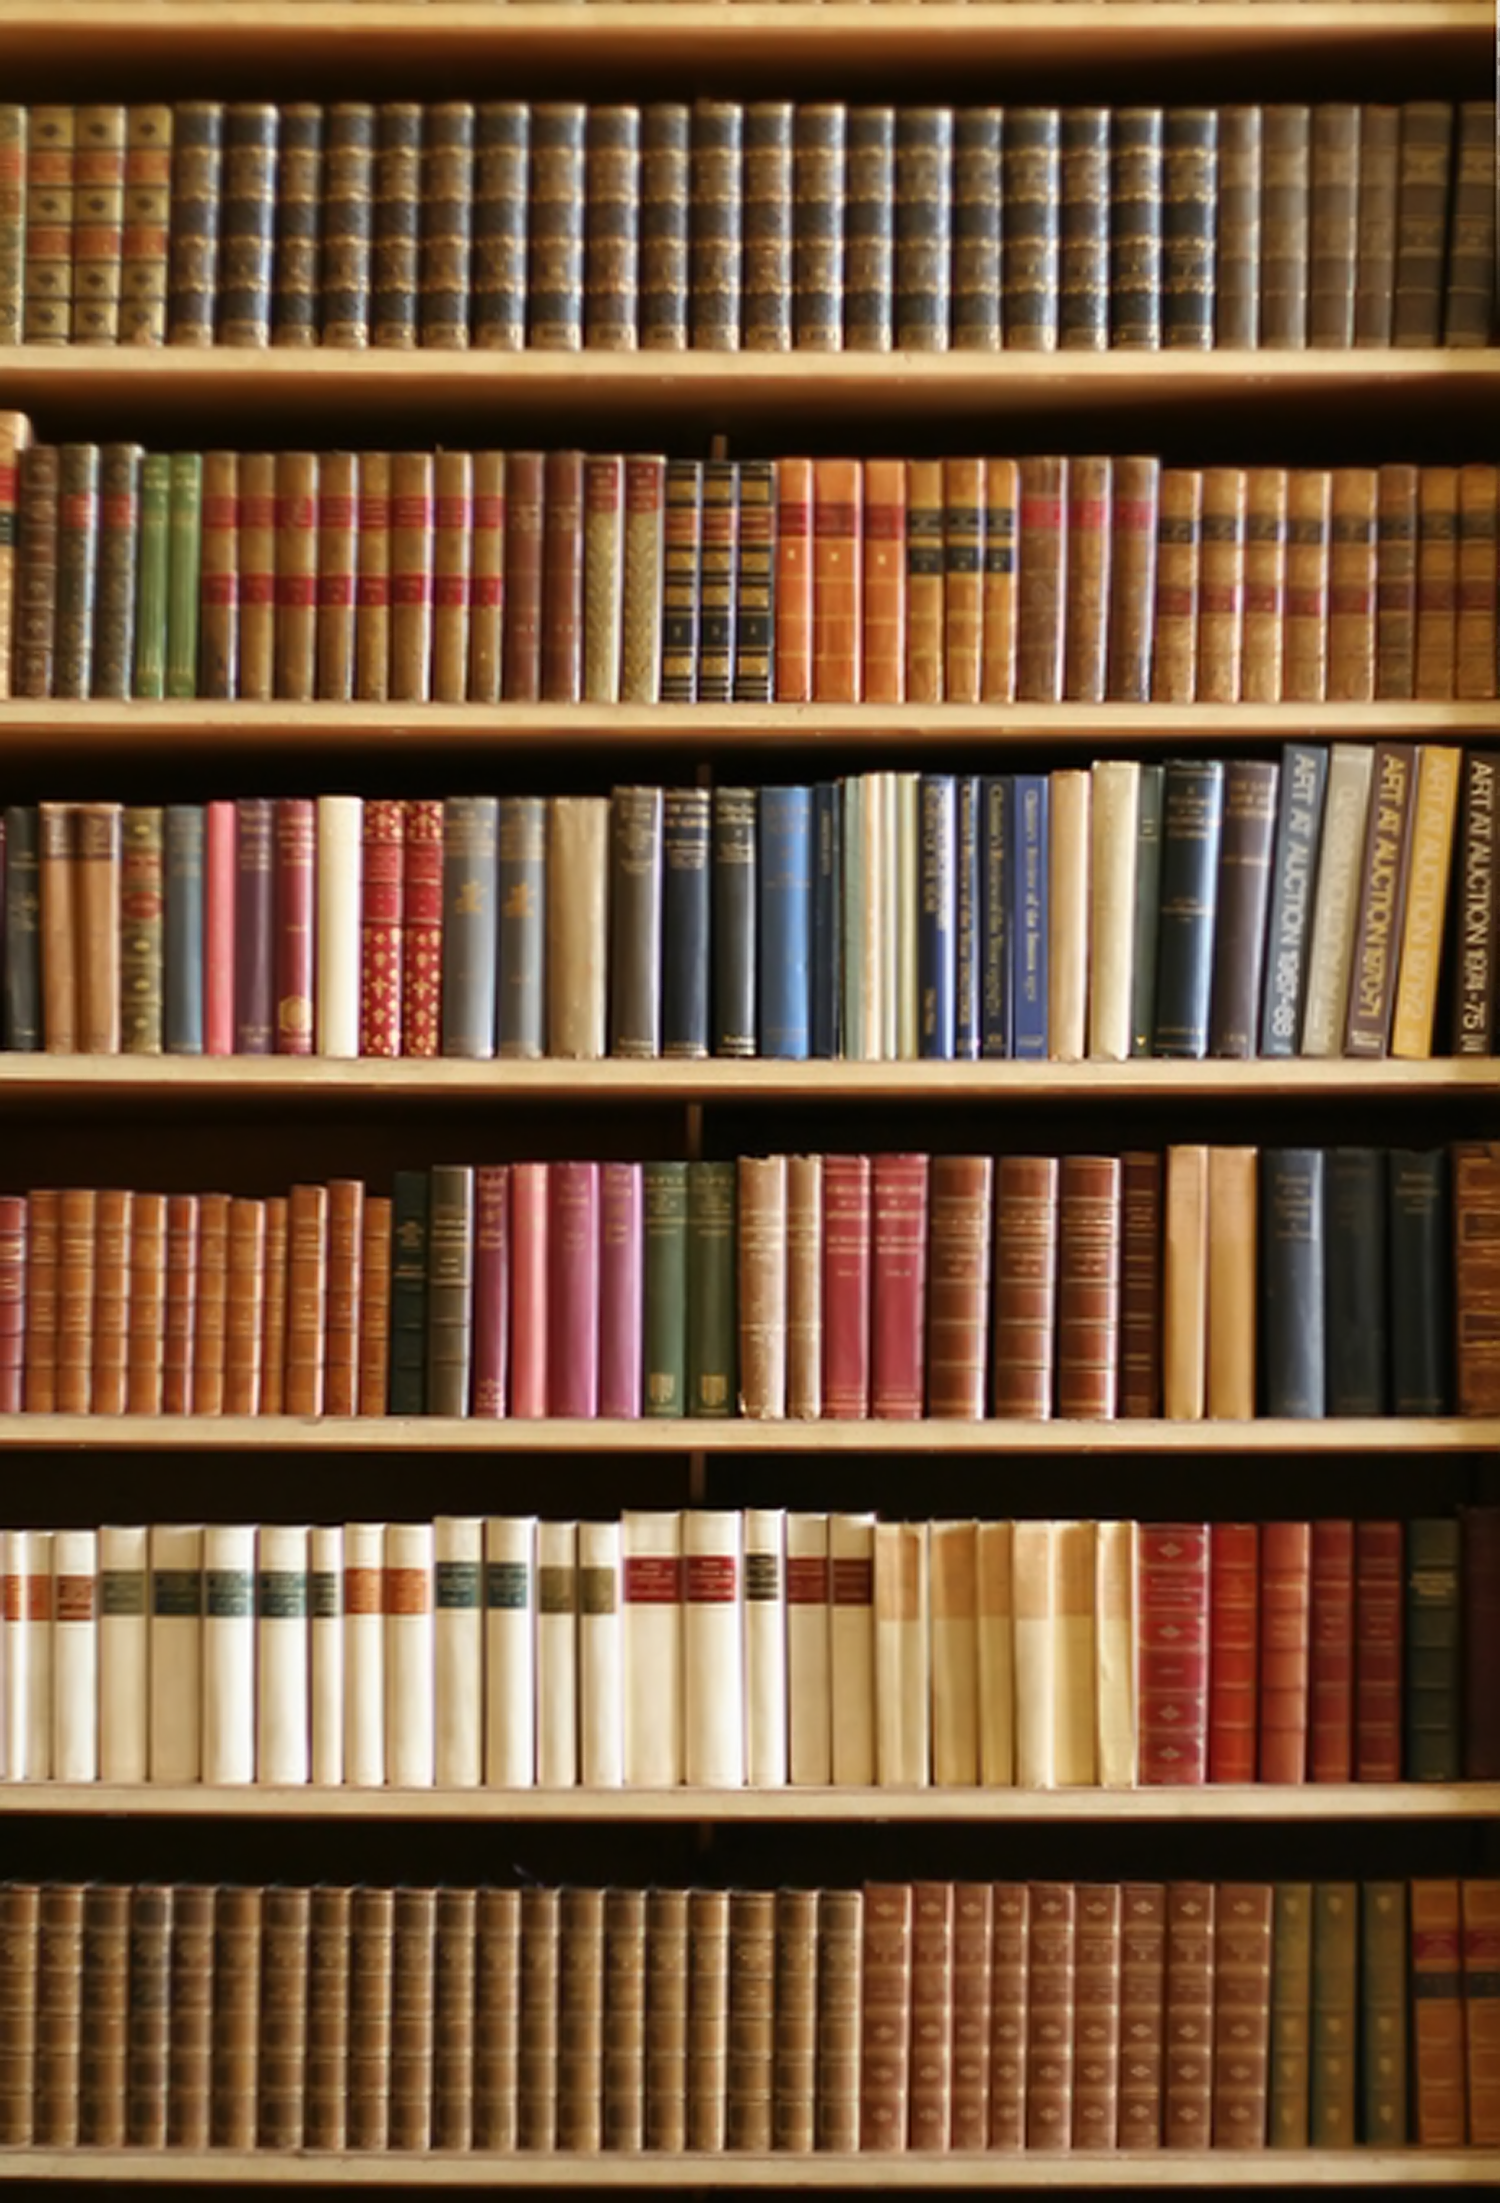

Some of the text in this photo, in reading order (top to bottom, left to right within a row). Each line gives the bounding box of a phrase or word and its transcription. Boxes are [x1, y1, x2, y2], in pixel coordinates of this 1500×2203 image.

[1292, 754, 1316, 805] ART
[1379, 754, 1406, 806] ART
[1427, 756, 1450, 808] ART
[1469, 760, 1493, 810] ART
[1288, 806, 1312, 837] AT
[1376, 806, 1400, 836] AT
[1424, 809, 1446, 836] AT
[1468, 811, 1492, 840] AT
[1281, 840, 1309, 944] AUCTION
[1366, 838, 1397, 946] AUCTION
[1411, 837, 1443, 943] AUCTION
[1465, 841, 1491, 943] AUCTION
[1462, 949, 1486, 1029] 1974-75
